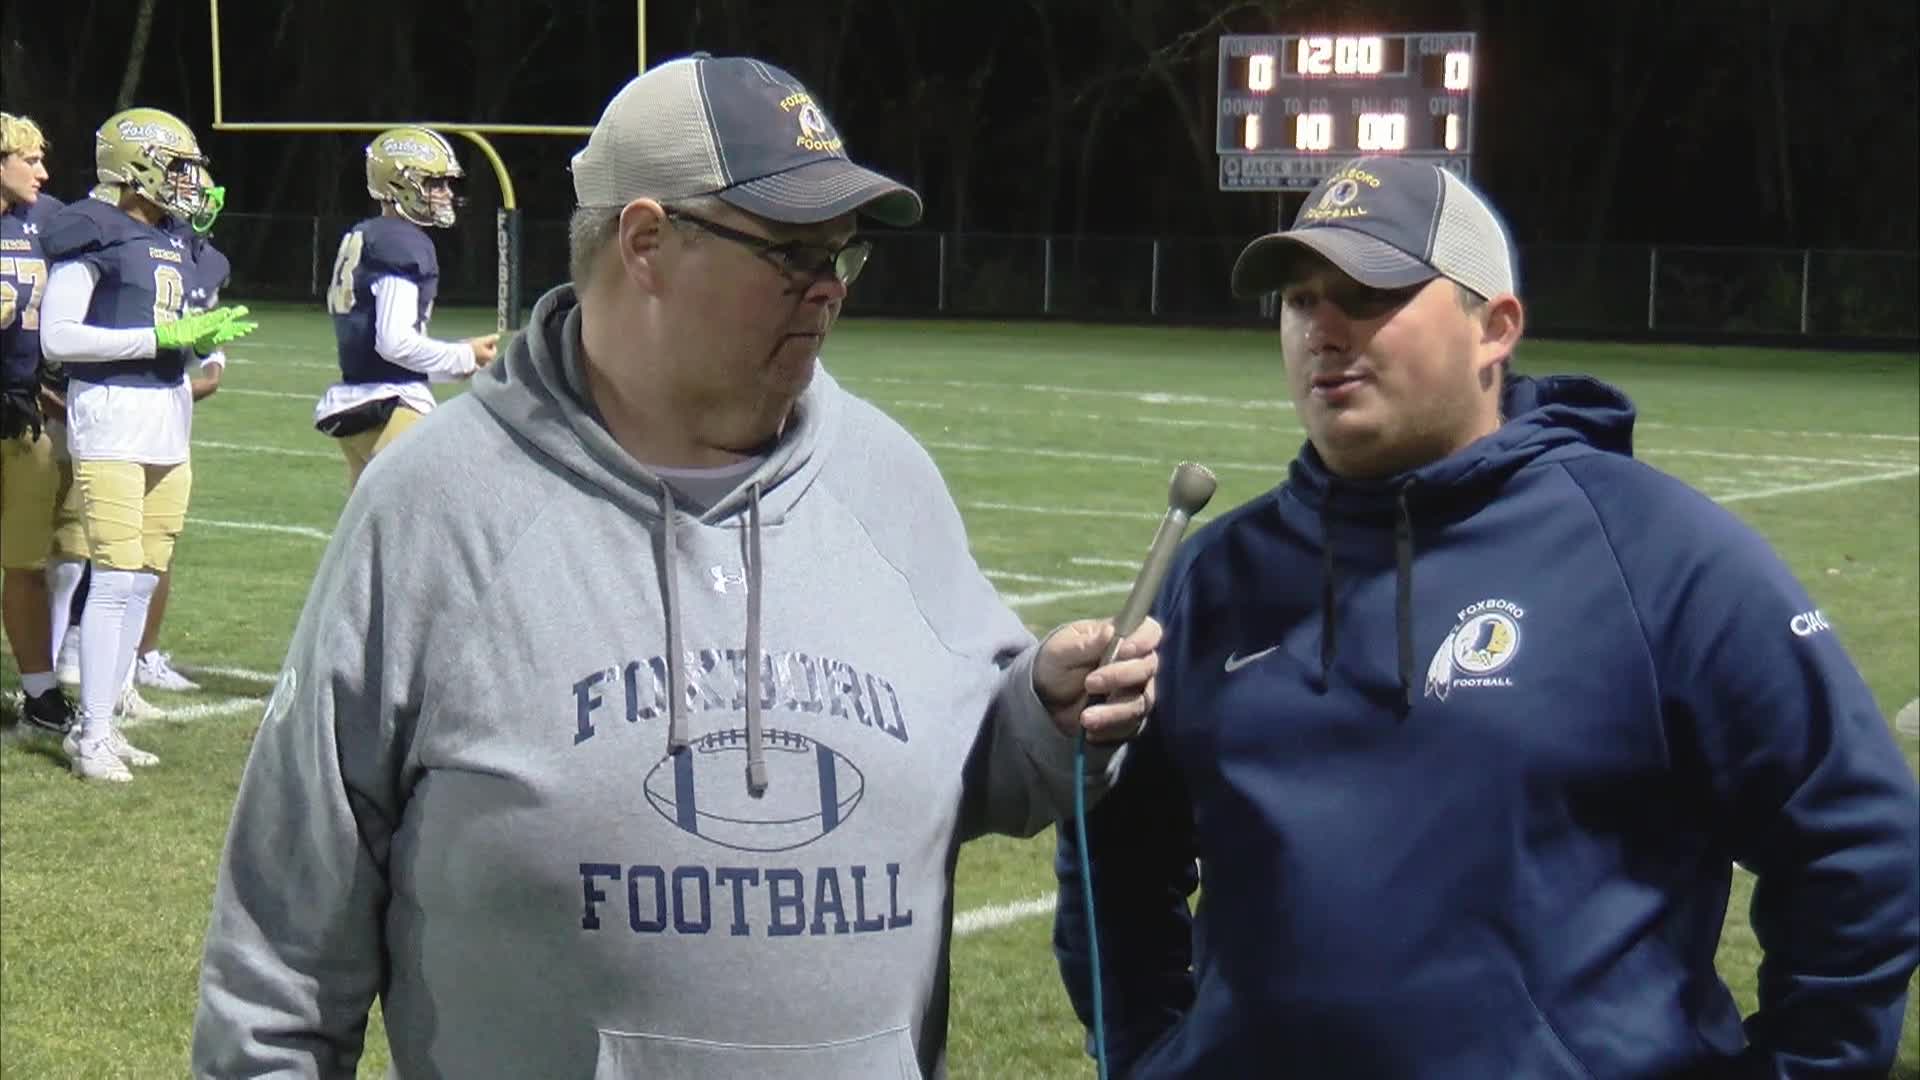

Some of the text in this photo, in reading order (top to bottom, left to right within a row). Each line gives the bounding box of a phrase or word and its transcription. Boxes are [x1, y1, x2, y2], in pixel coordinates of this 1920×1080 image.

[1248, 54, 1274, 91] 0
[1443, 52, 1469, 90] 0
[1223, 98, 1264, 114] DOWN
[1283, 98, 1303, 114] TO
[1245, 114, 1259, 150] 1
[1295, 113, 1331, 150] 10
[1357, 113, 1406, 150] 00
[1445, 113, 1460, 150] 1
[1456, 598, 1525, 622] FOXBORO
[572, 648, 911, 746] FOXBORO
[1452, 676, 1514, 689] FOOTBALL
[579, 862, 913, 938] FOOTBALL
